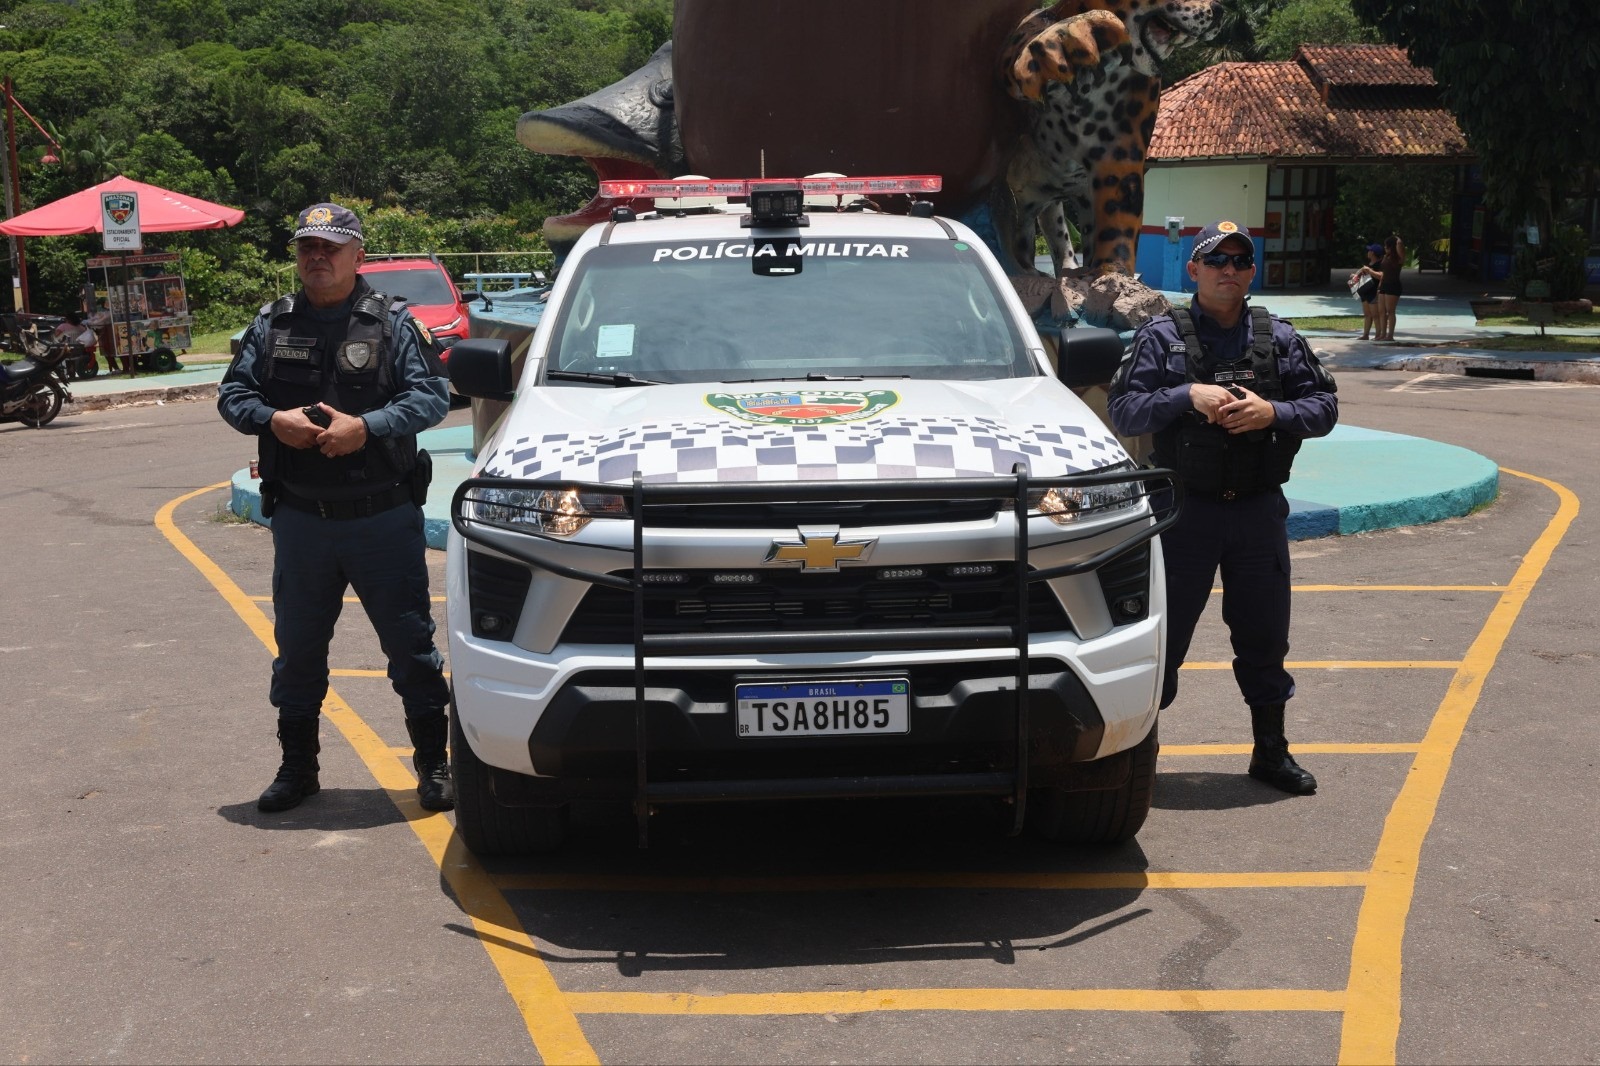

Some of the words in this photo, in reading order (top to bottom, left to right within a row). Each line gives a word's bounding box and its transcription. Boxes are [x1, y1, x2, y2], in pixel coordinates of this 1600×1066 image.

[653, 242, 777, 262] POLÍCIA
[785, 243, 909, 258] MILITAR
[714, 390, 886, 399] AMAZONAS
[808, 688, 836, 696] BRASIL
[752, 699, 889, 732] TSA8H85
[739, 724, 750, 734] BR
